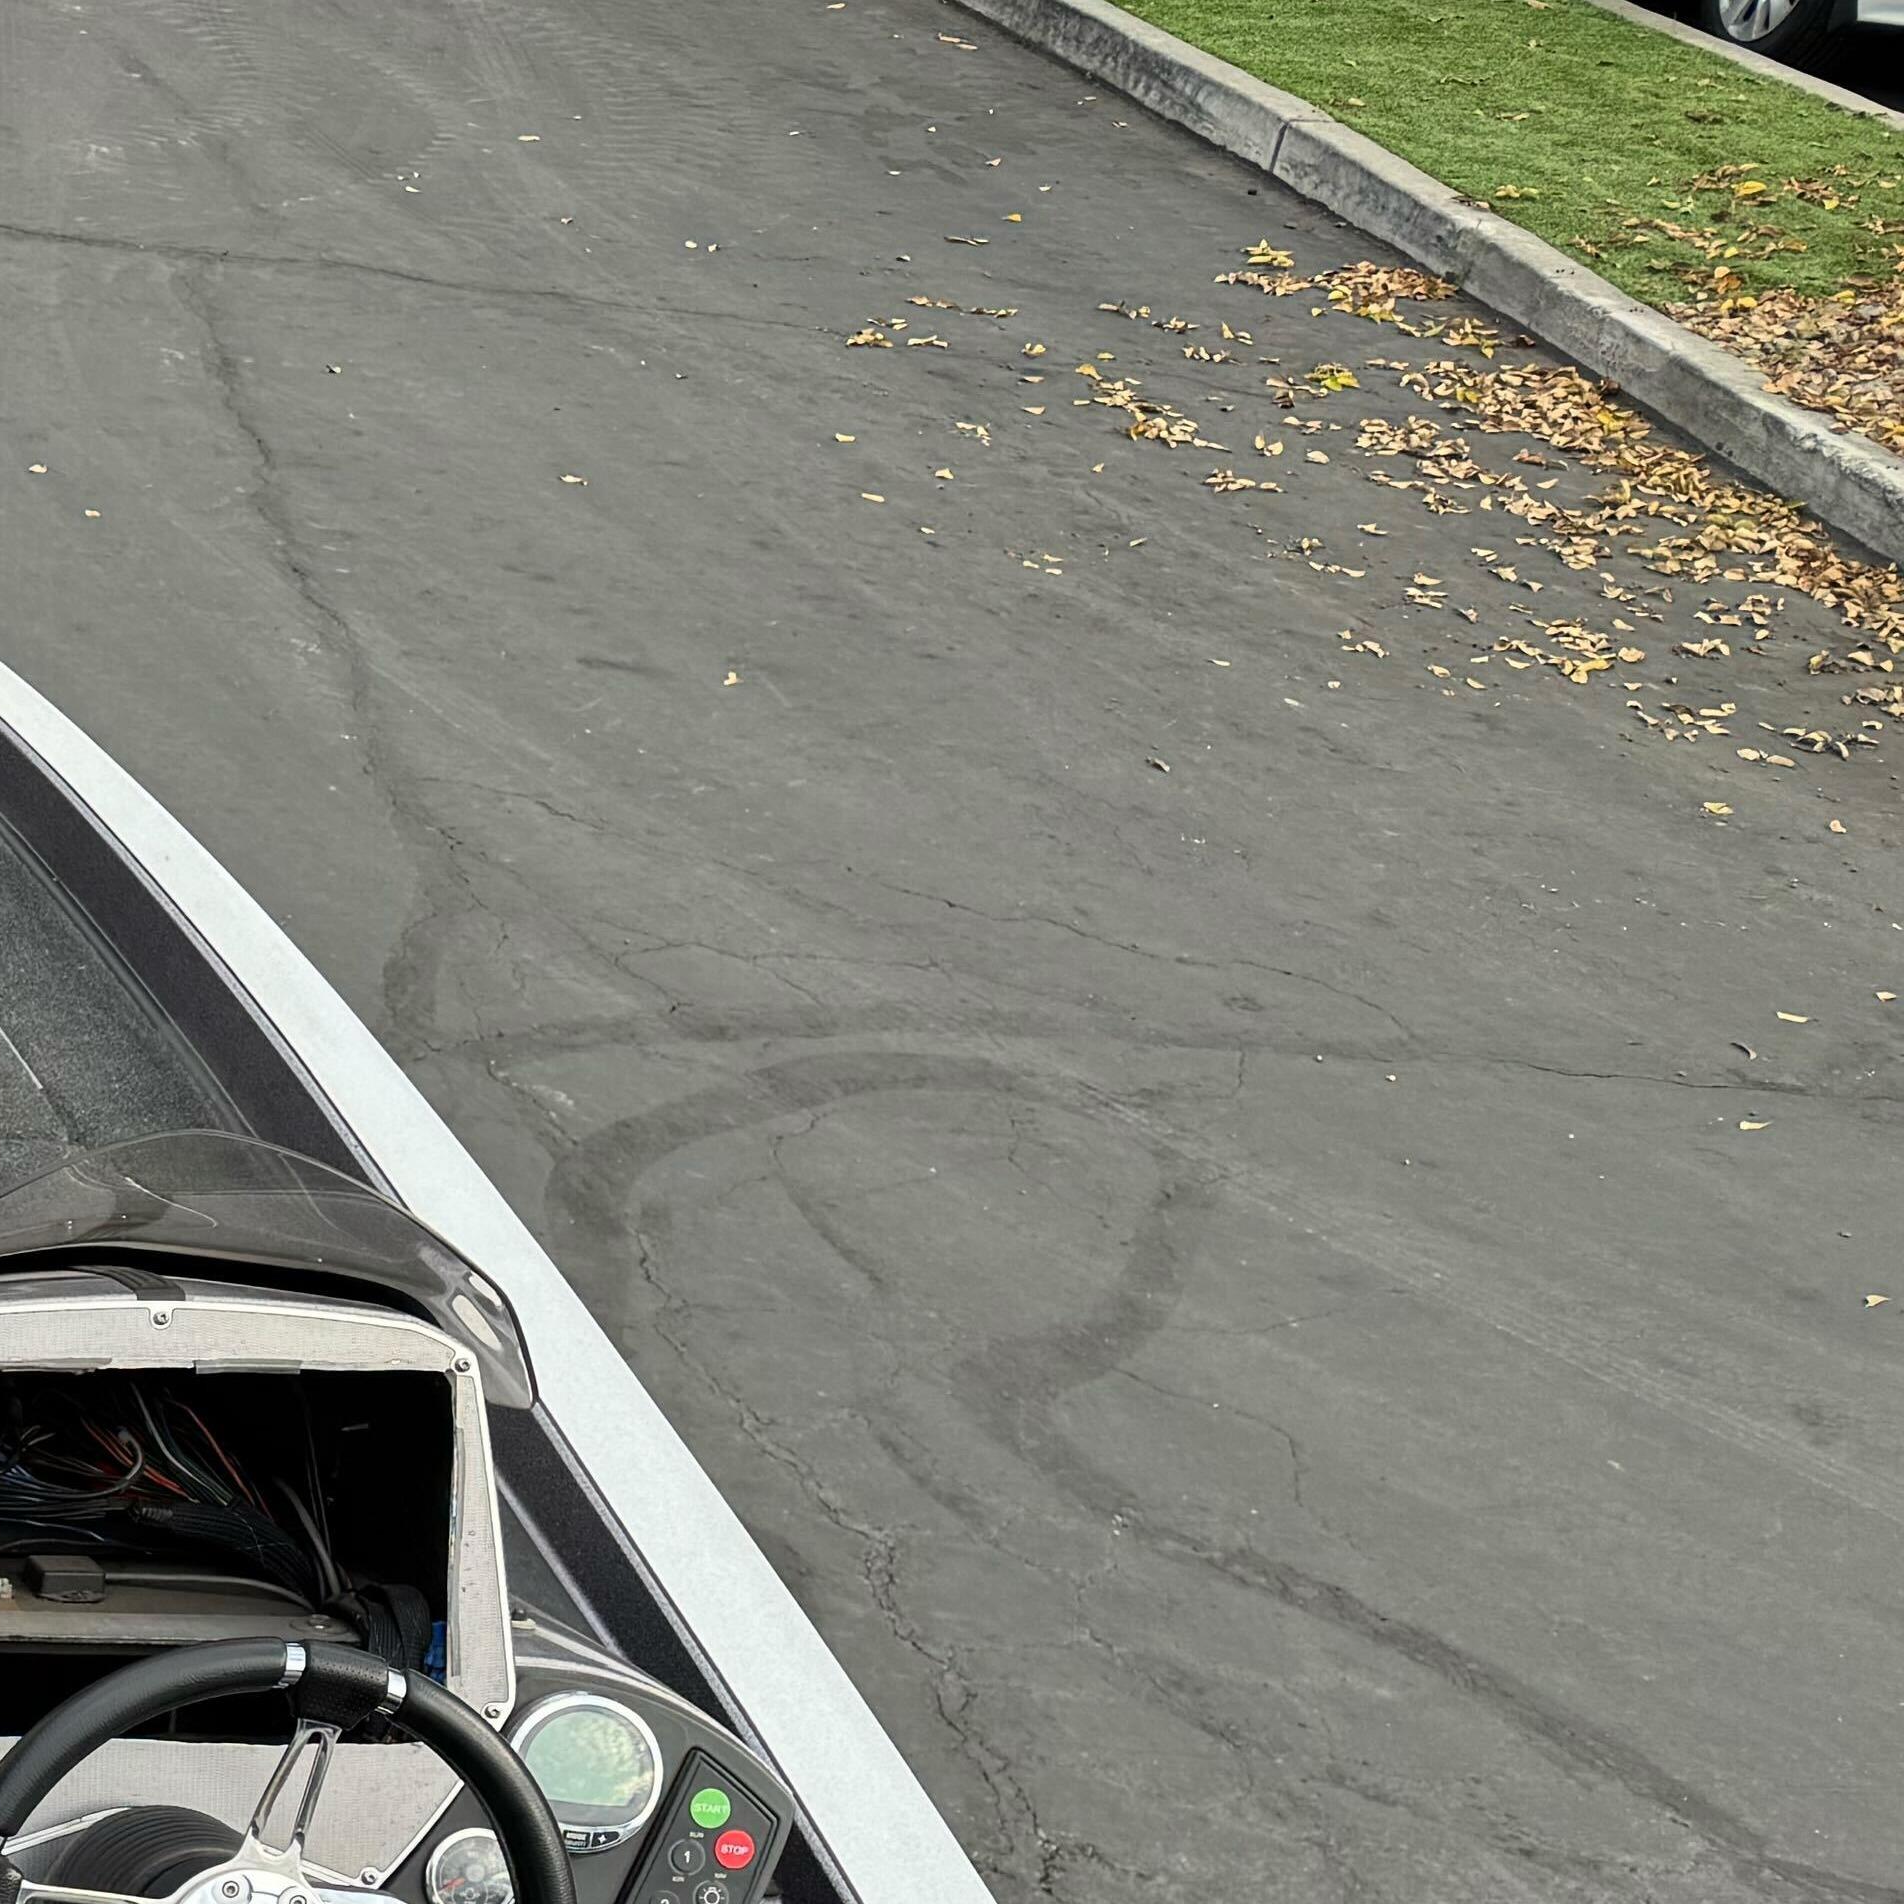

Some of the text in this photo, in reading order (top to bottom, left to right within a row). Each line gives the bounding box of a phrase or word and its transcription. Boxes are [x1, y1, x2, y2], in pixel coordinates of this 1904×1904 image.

[693, 1803, 729, 1814] START
[720, 1844, 750, 1855] STOP
[683, 1850, 691, 1863] 1
